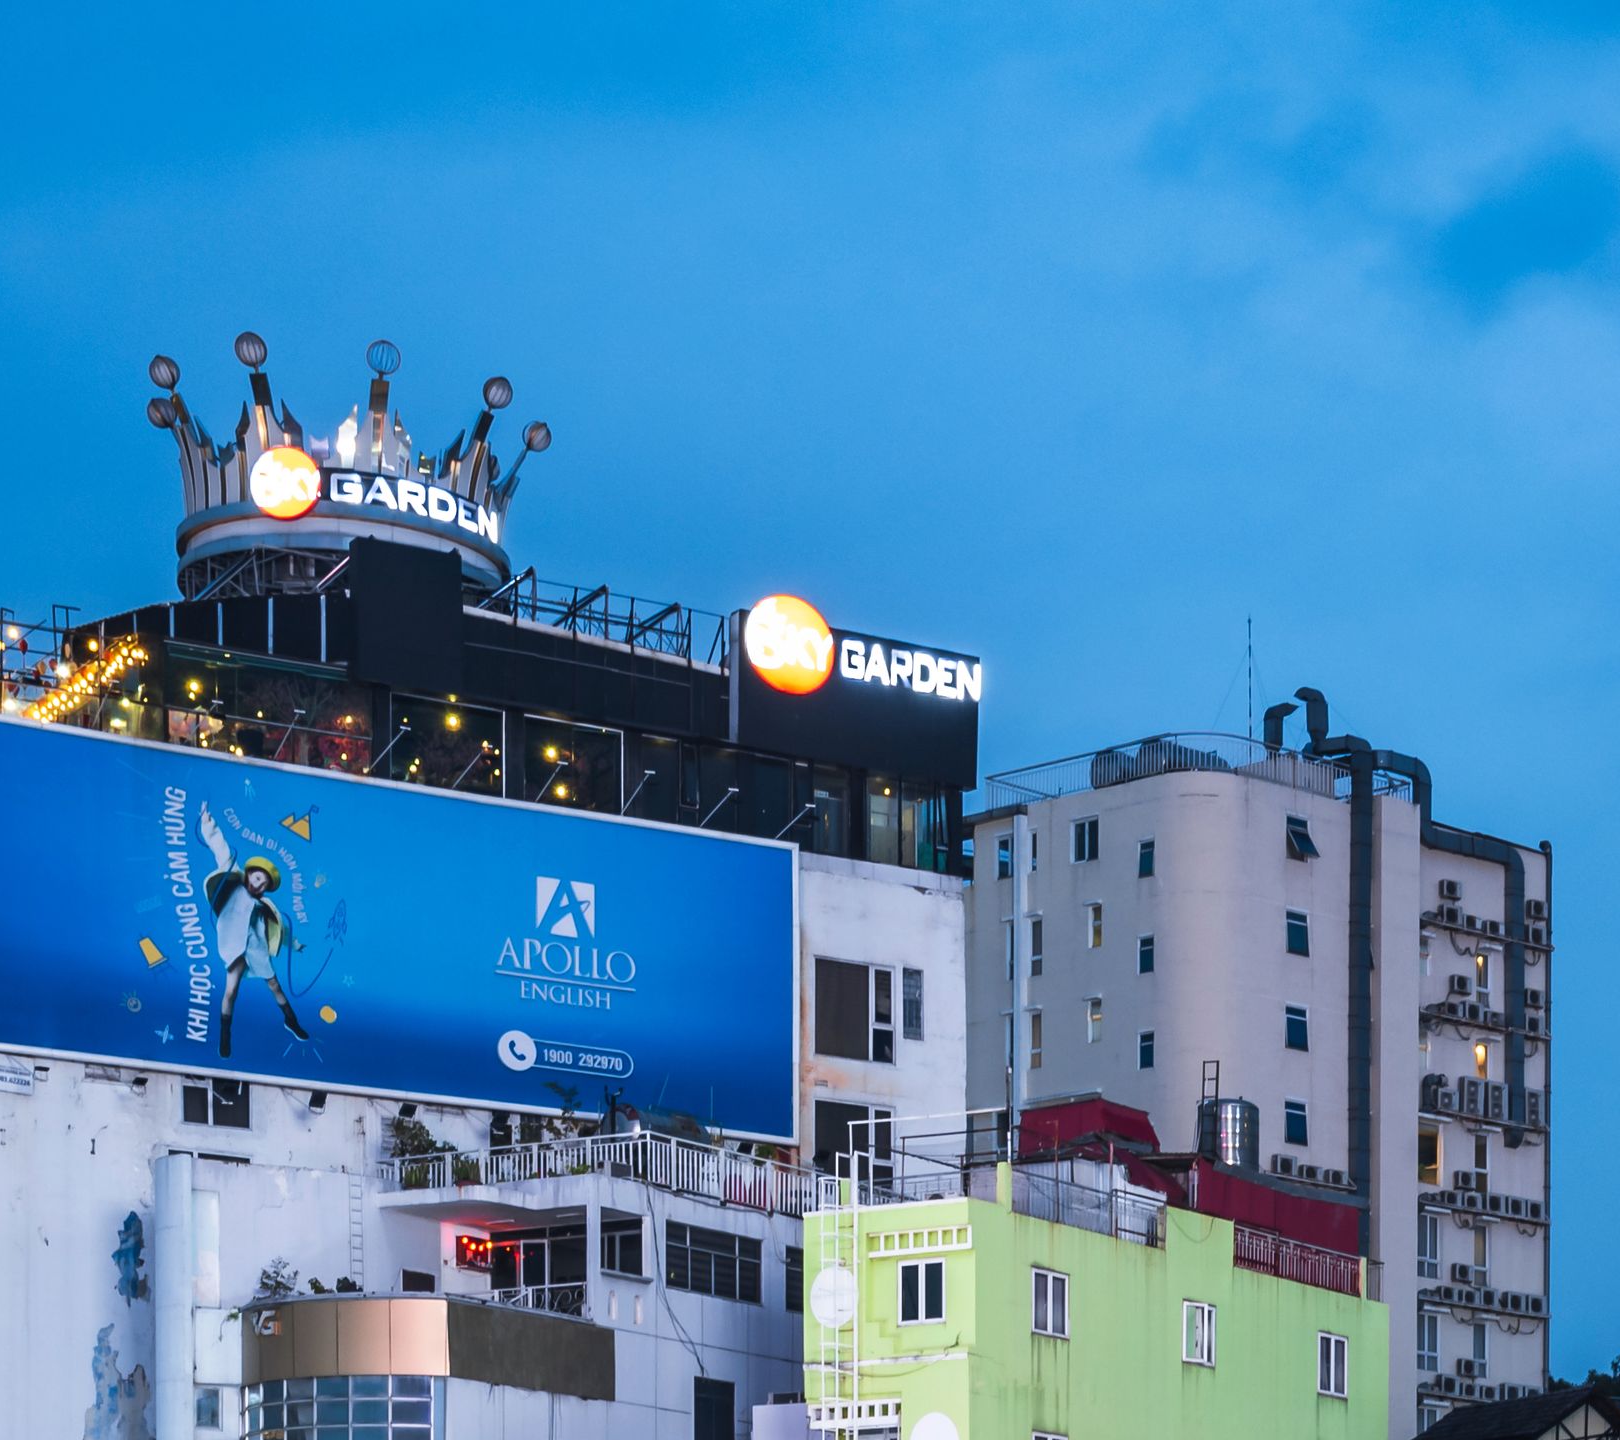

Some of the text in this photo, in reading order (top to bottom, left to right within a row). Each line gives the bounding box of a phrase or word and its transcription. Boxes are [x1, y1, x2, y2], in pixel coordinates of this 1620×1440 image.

[330, 472, 498, 545] GARDEN
[841, 639, 982, 702] GARDEN
[157, 786, 216, 1043] KHI HỌC CÙNG CẢM HỨNG
[496, 936, 637, 984] APOLLO
[520, 980, 612, 1010] ENGLISH
[543, 1048, 624, 1072] 1900 292970
